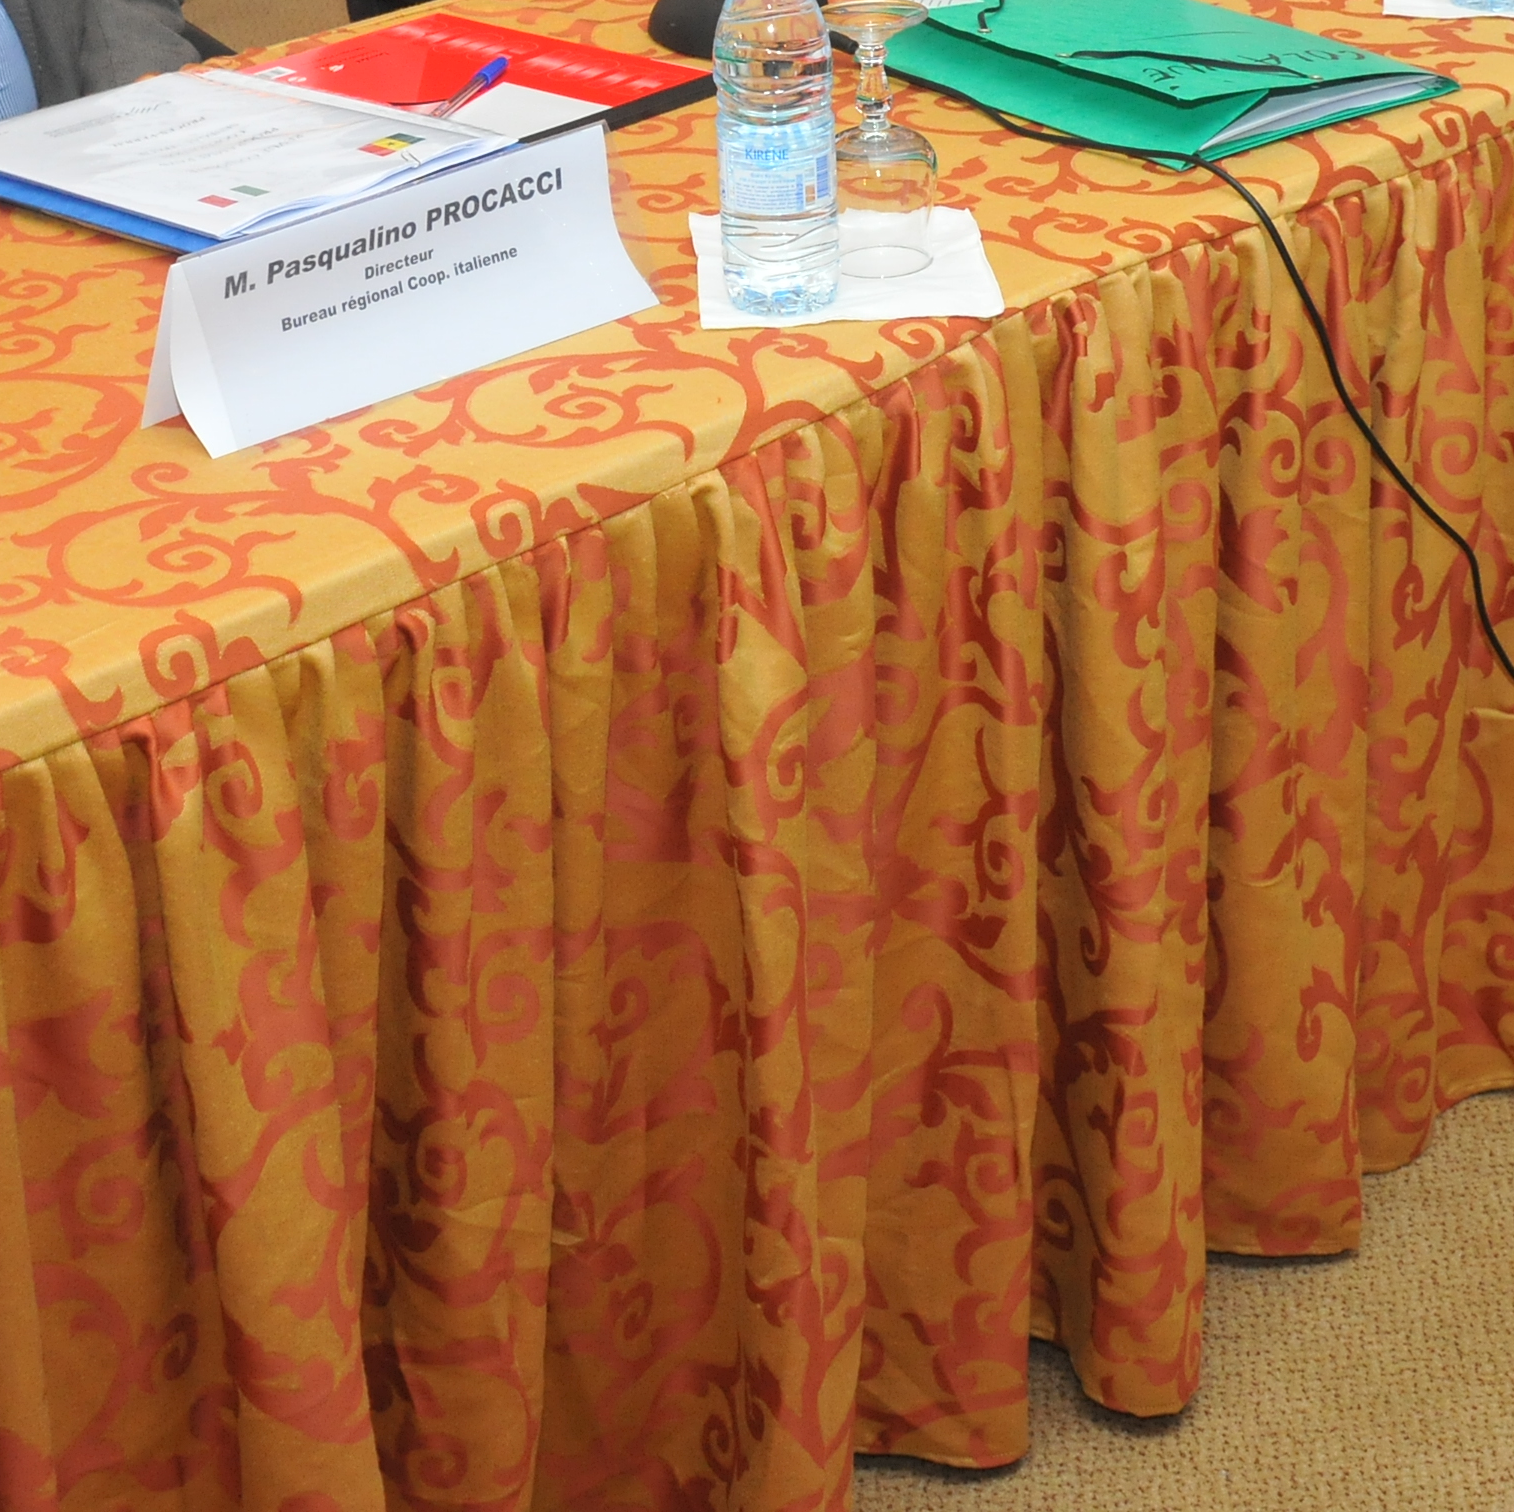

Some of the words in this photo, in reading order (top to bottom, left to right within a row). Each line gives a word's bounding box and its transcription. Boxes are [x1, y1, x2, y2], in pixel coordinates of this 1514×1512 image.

[223, 271, 256, 299] M.
[266, 221, 418, 285] Pasqualino
[425, 168, 563, 233] PROCACCI
[364, 247, 435, 280] Directeur
[281, 303, 337, 332] Bureau
[341, 280, 404, 314] régional
[407, 266, 452, 292] Coop.
[453, 244, 519, 277] italienne
